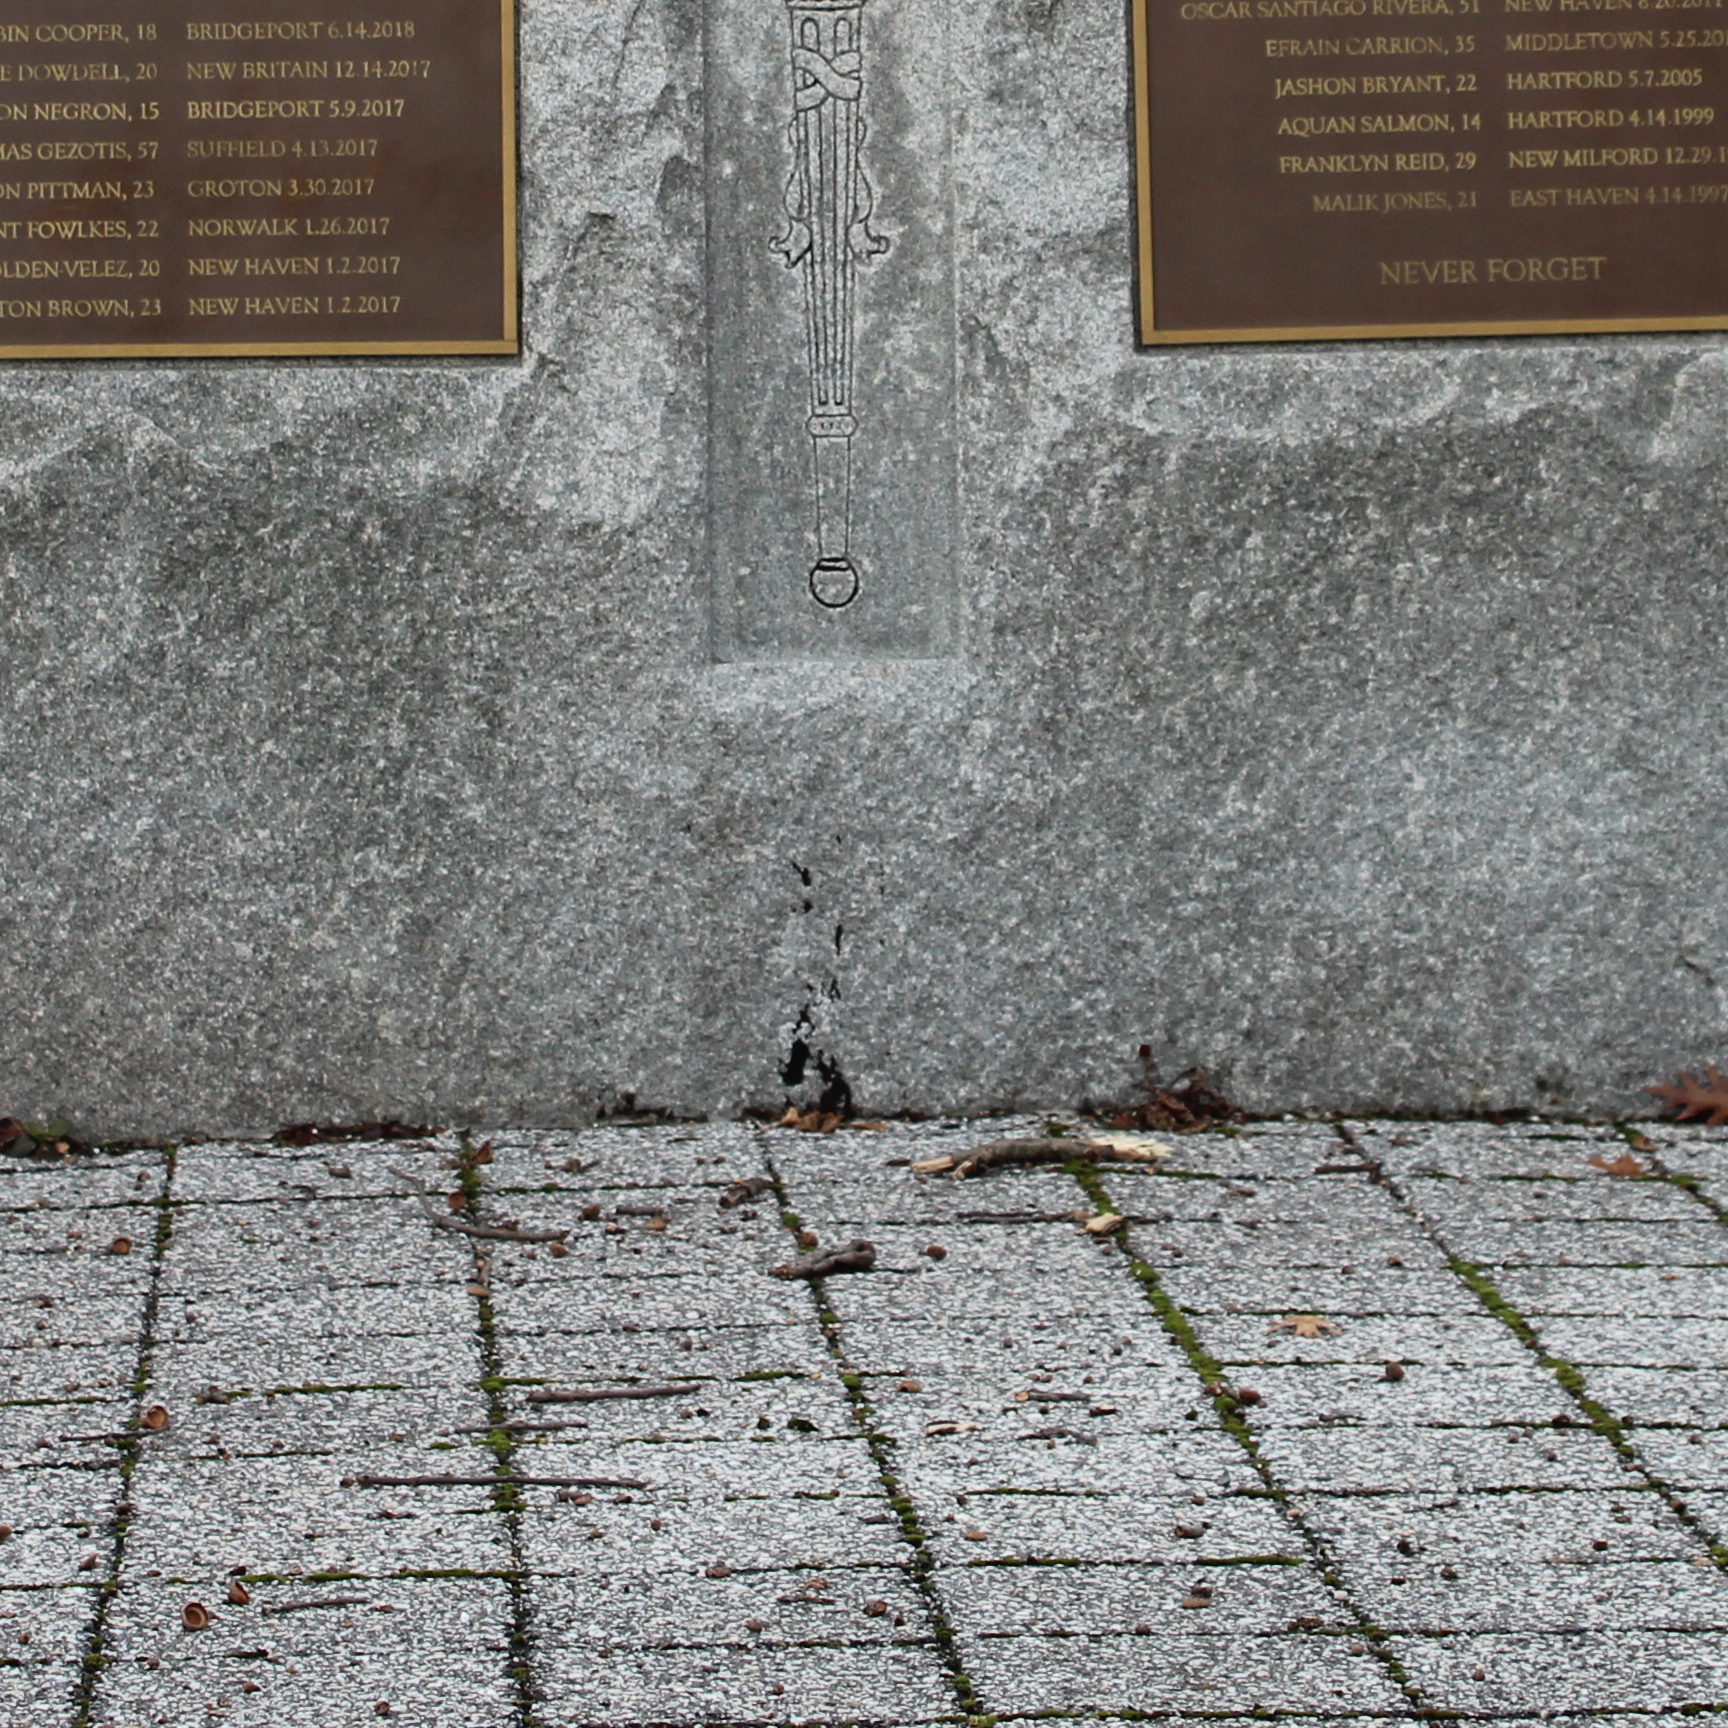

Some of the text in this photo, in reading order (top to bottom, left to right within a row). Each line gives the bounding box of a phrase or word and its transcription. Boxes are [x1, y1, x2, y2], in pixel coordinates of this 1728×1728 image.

[1180, 1, 1252, 20] OSCAR
[1257, 0, 1367, 18] SANTIAGO
[35, 24, 129, 43] COOPER,
[137, 24, 157, 40] 18
[187, 21, 415, 40] BRIDGEPORT 6.14.2018
[1506, 30, 1653, 51] MIDDLETOWN
[1265, 35, 1475, 57] EFRAIN CARRION, 35
[18, 63, 130, 82] DOWDELL,
[136, 63, 157, 80] 20
[187, 60, 430, 80] NEW BRITAIN 12.14.2017
[1507, 68, 1702, 90] HARTFORD 5.7.2005
[1275, 74, 1477, 99] JASHON BRYANT, 22
[34, 103, 132, 122] NEGRON,
[141, 102, 159, 119] 15
[187, 99, 404, 119] BRIDGEPORT 5.9.2017
[1508, 107, 1714, 129] HARTFORD 4.14.1999
[1277, 113, 1481, 137] AQUAN SALMON, 14
[37, 142, 132, 161] GEZOTIS,
[138, 141, 159, 159] 57
[187, 139, 378, 157] SUFFIELD 4.13.2017
[1508, 150, 1559, 168] NEW
[1563, 147, 1658, 167] MILFORD
[1279, 152, 1477, 173] FRANKLYN REID, 29
[27, 182, 127, 200] PITTMAN,
[133, 180, 154, 198] 23
[187, 178, 374, 197] GROTON 3.30.2017
[1510, 188, 1562, 207] EAST
[1565, 187, 1639, 205] HAVEN
[1313, 191, 1477, 214] MALIK JONES, 21
[27, 221, 131, 240] FOWLKES,
[137, 220, 159, 237] 22
[189, 217, 390, 236] NORWALK 1.26.2017
[139, 259, 160, 276] 20
[188, 256, 400, 275] NEW HAVEN 1.2.2017
[1379, 256, 1607, 284] NEVER FORGET
[47, 299, 134, 318] BROWN,
[141, 298, 161, 316] 23
[189, 296, 400, 315] NEW HAVEN 1.2.2017
